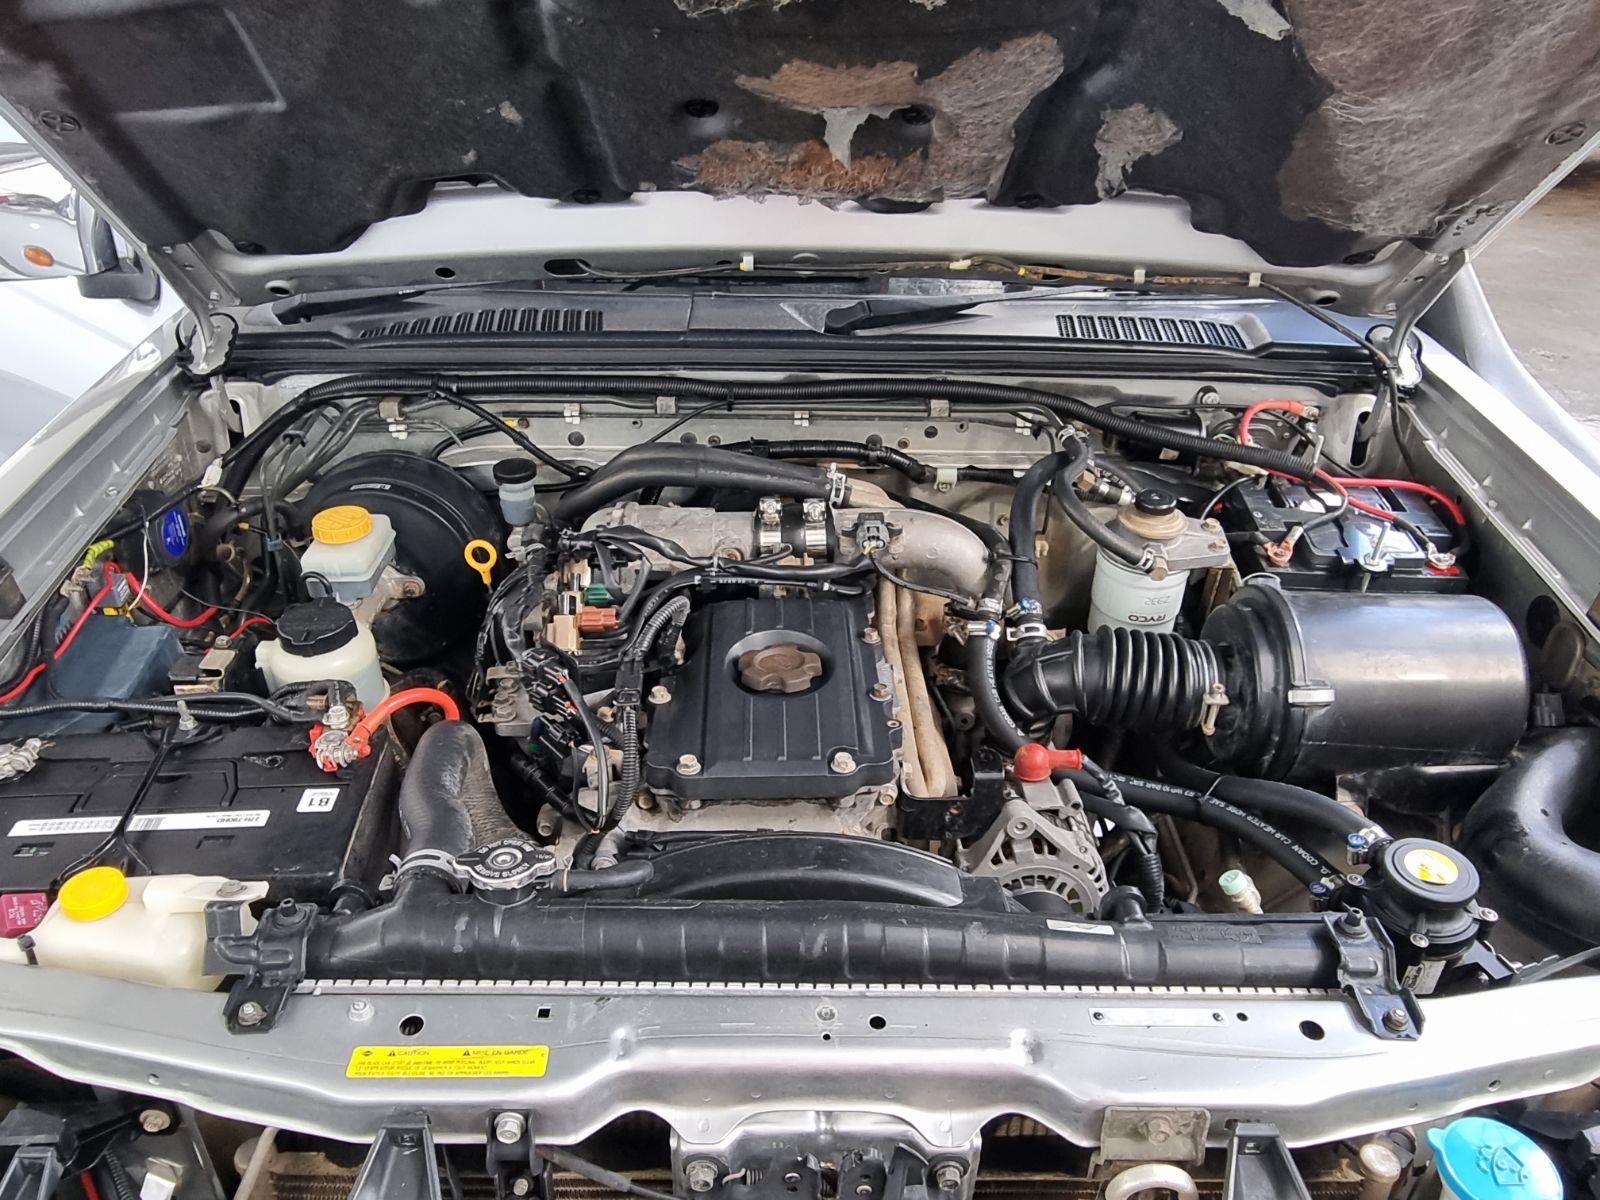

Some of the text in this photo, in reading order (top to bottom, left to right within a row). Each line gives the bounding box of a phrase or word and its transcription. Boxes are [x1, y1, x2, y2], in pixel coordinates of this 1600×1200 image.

[1128, 614, 1167, 623] RYCO
[308, 797, 331, 807] B1
[1225, 806, 1247, 817] HOSE
[1246, 815, 1276, 834] HEATER
[1274, 832, 1292, 845] CAR
[1291, 844, 1318, 866] CODAN
[501, 862, 530, 878] SLOWLY
